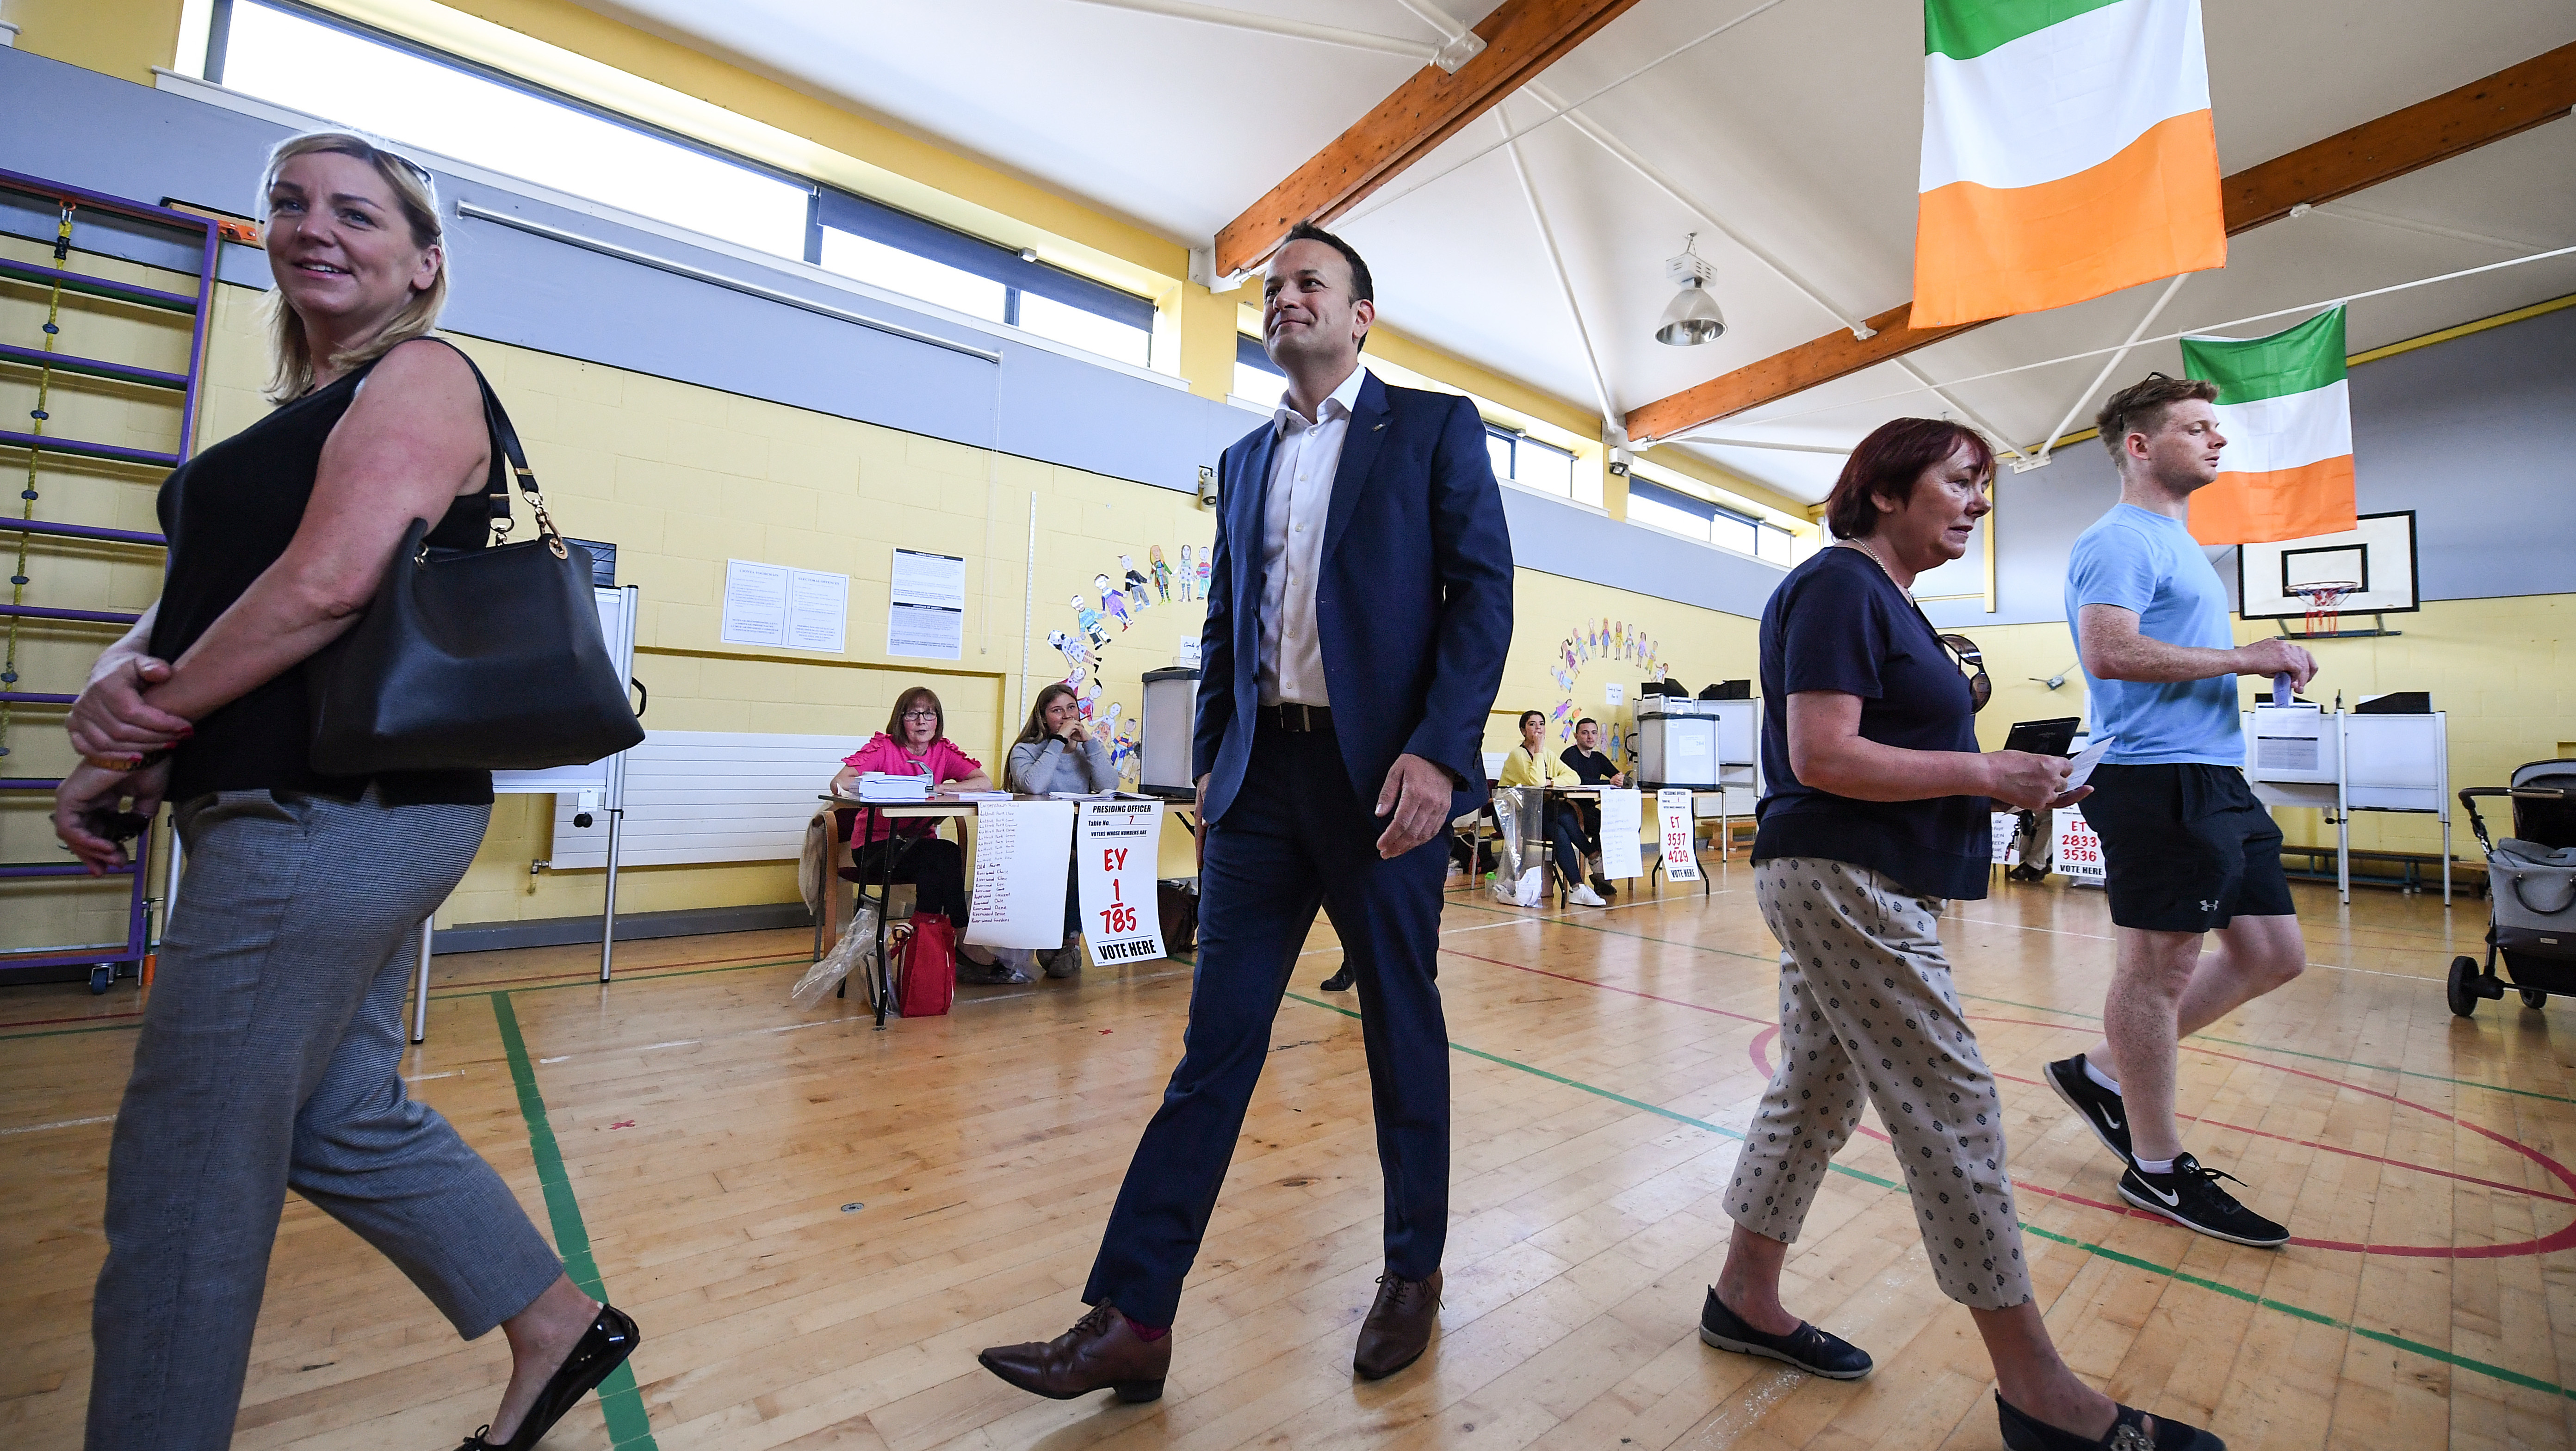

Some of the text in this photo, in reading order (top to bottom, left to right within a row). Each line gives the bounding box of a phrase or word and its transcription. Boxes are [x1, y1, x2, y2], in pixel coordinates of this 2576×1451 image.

[1129, 815, 1134, 824] 7
[1670, 816, 1679, 828] ET
[2072, 821, 2087, 832] ET
[1667, 833, 1686, 846] 3537
[2062, 834, 2097, 847] 2833
[1104, 848, 1128, 871] EY
[1668, 850, 1688, 863] 4229
[2062, 849, 2097, 862] 3536
[1671, 869, 1695, 878] VOTE HERE
[2060, 864, 2102, 875] VOTE HERE
[1113, 878, 1120, 901] 1
[1100, 907, 1136, 934] 785
[1098, 939, 1157, 960] VOTE HERE
